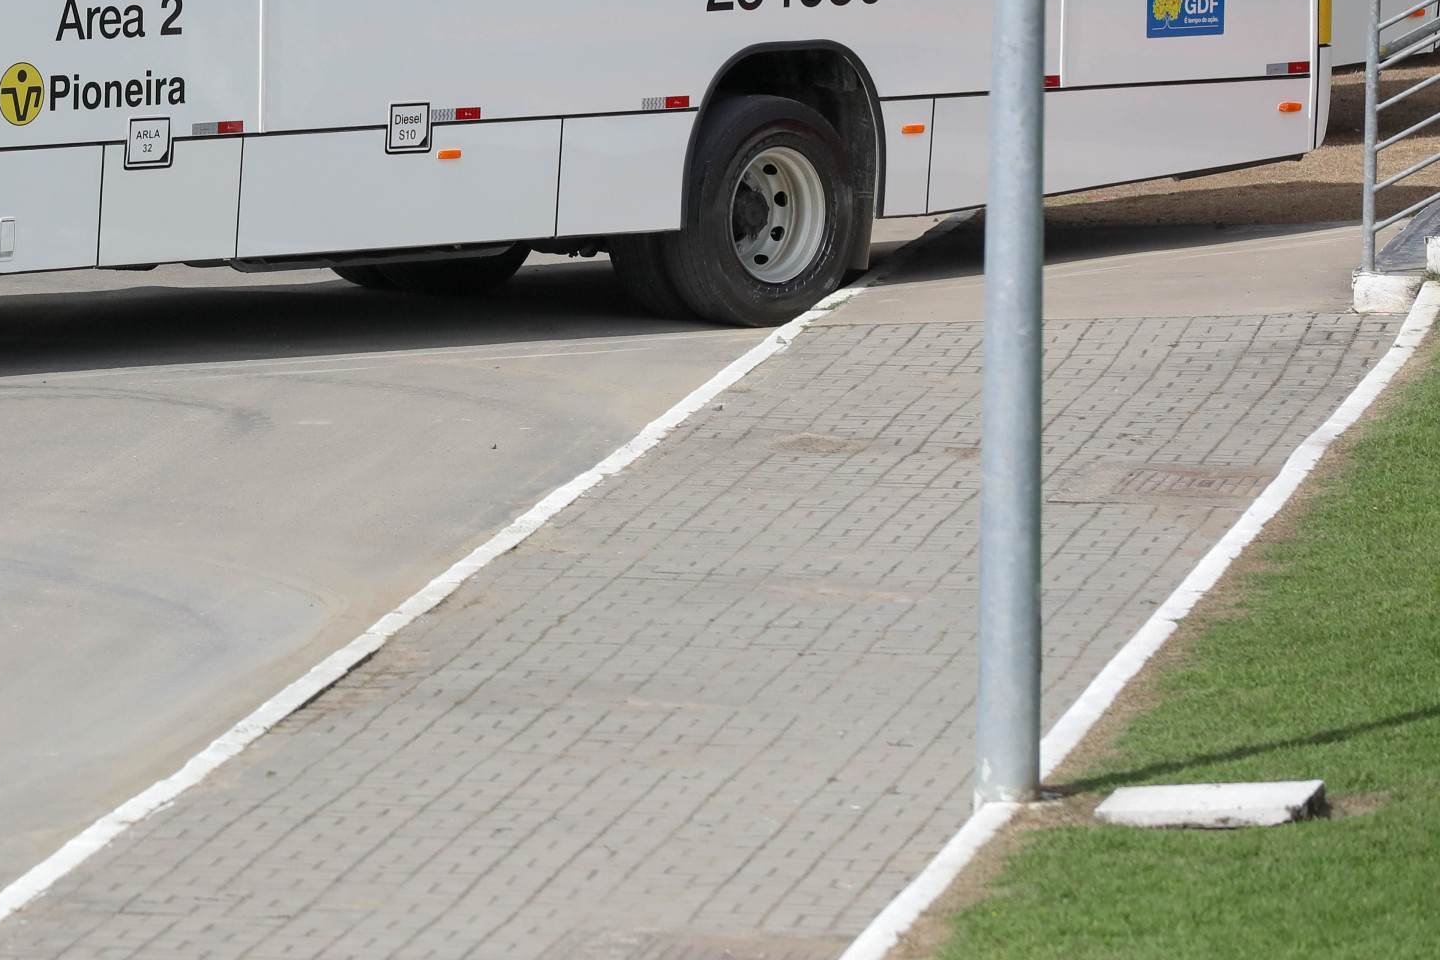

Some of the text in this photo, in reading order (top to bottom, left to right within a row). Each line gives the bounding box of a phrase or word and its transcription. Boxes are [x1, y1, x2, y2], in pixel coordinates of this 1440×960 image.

[49, 69, 186, 112] Pioneira
[394, 113, 422, 126] Diesel
[135, 129, 161, 140] ARLA
[398, 129, 416, 141] S10
[142, 143, 153, 153] 32
